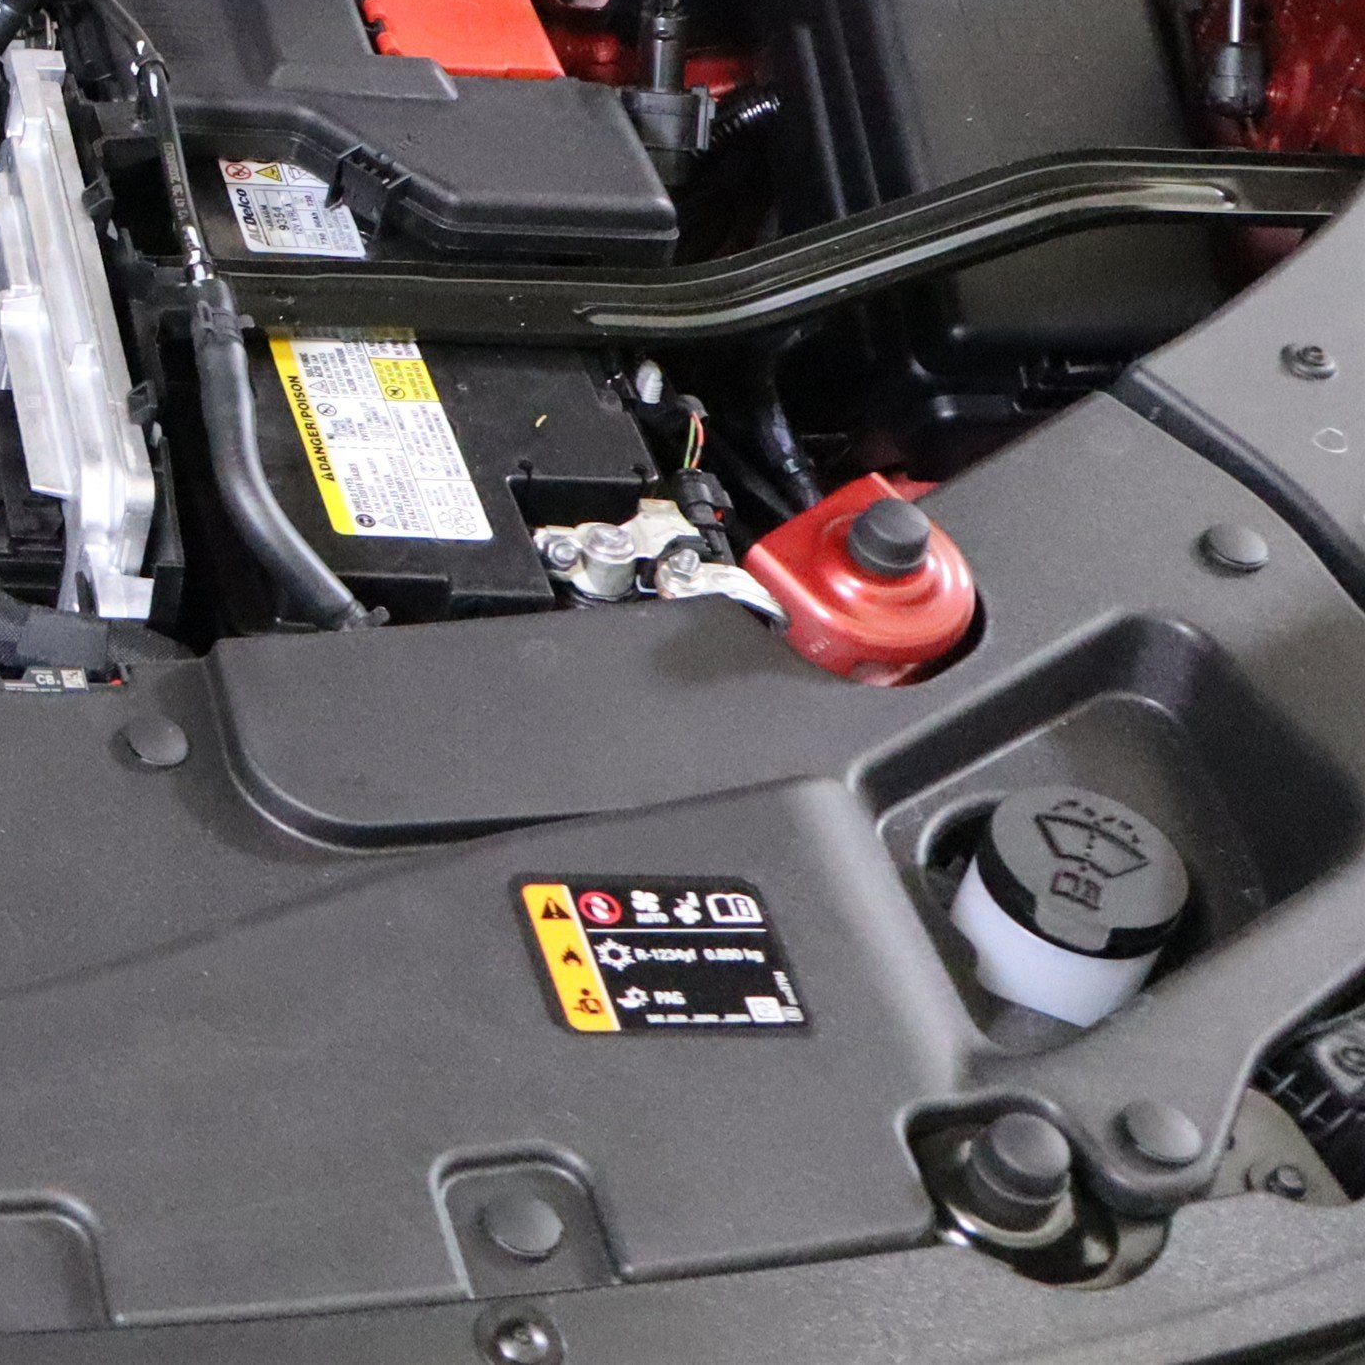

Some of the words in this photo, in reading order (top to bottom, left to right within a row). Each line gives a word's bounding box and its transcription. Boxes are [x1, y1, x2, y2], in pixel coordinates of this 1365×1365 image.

[236, 188, 263, 243] ACDelco
[271, 205, 290, 231] 9354
[288, 376, 333, 470] DANGER/POISON
[636, 913, 670, 924] AUTO
[634, 948, 698, 963] R-1234yf
[653, 990, 687, 1005] PAG
